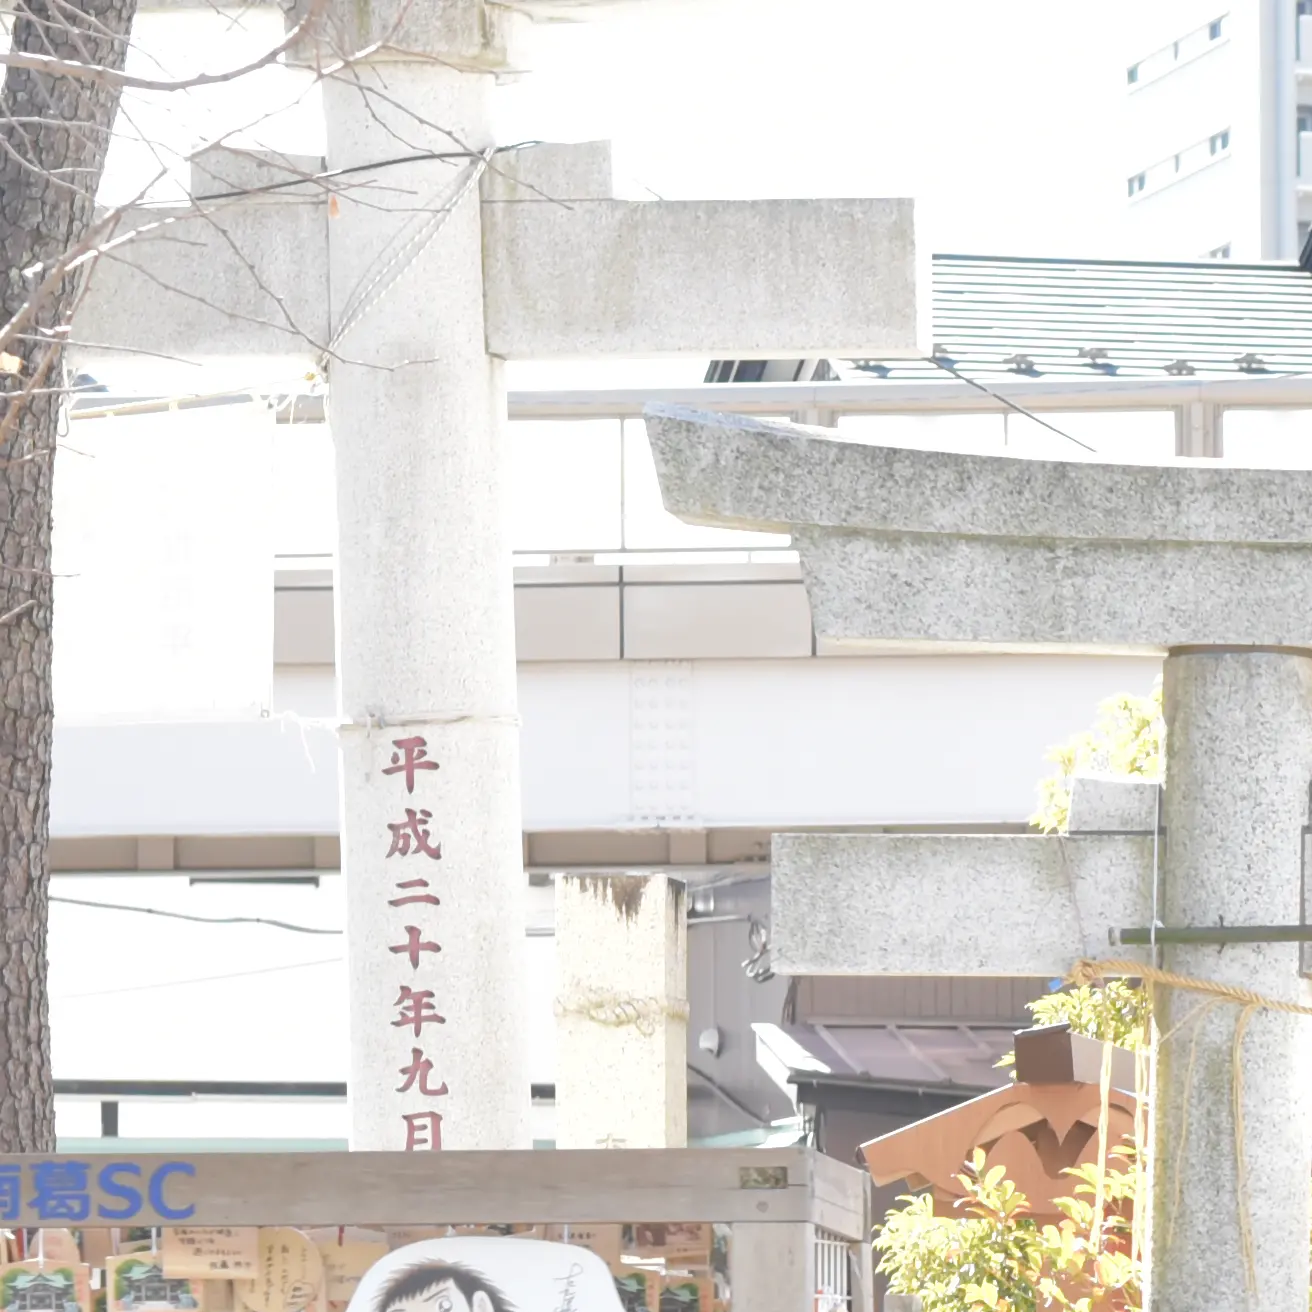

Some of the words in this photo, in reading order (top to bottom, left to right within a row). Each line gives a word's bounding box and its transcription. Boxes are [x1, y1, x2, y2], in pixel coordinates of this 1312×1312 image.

[381, 736, 449, 1151] 平成二十年九月
